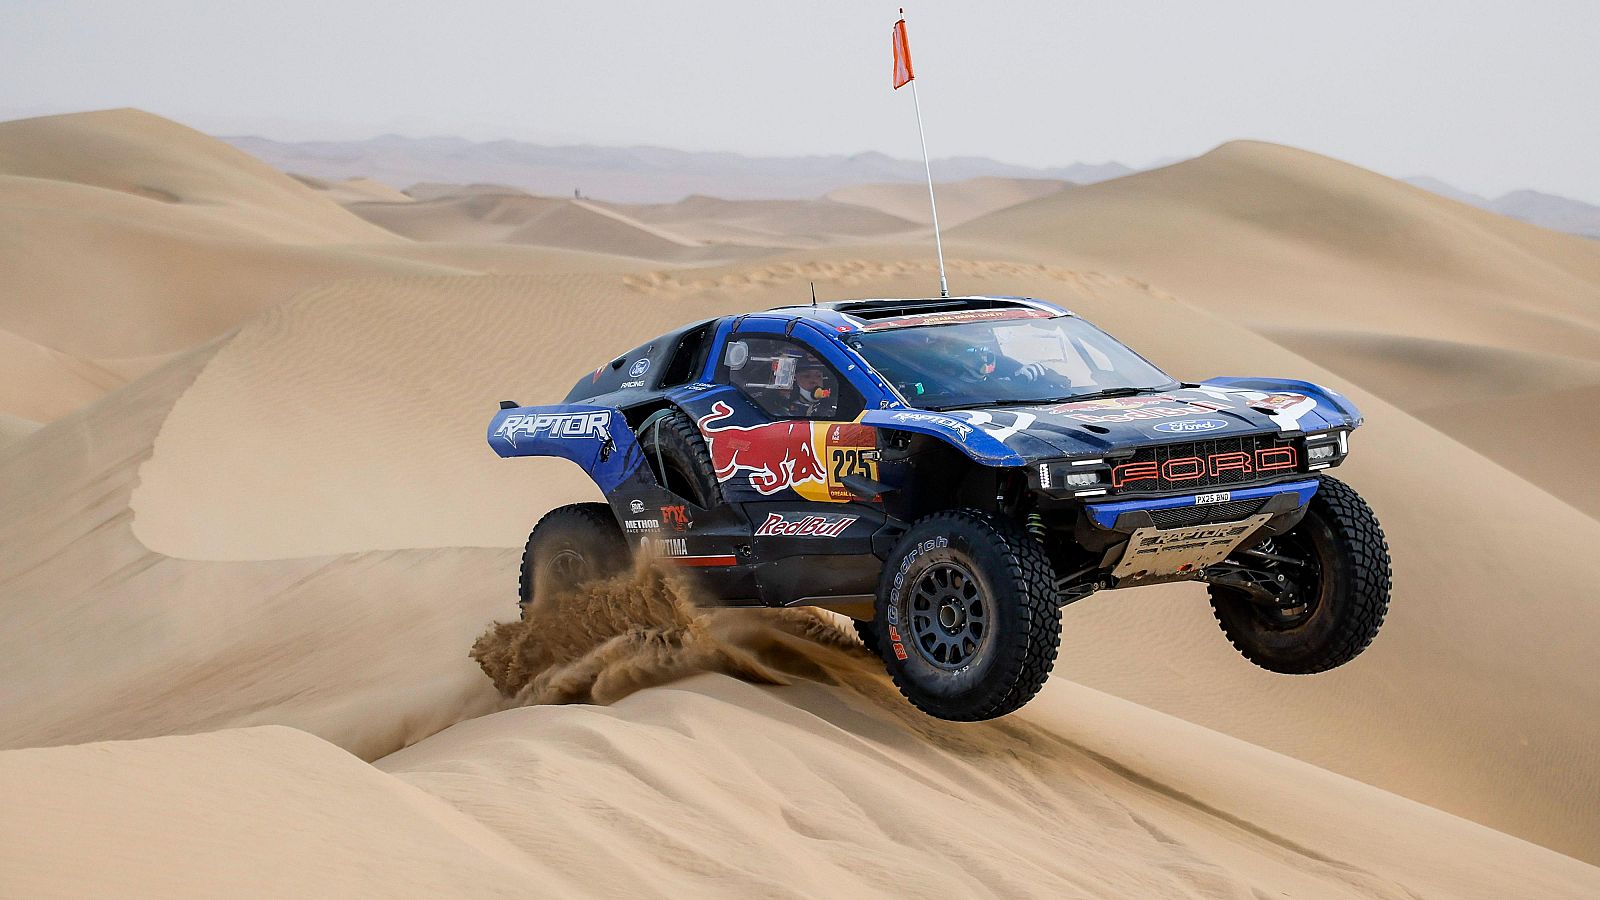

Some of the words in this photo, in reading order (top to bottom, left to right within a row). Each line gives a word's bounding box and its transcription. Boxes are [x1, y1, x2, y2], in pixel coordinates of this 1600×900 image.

[631, 361, 647, 375] Ford
[620, 381, 645, 389] RACING
[494, 410, 617, 452] RAPTOR
[890, 412, 974, 442] RAPTOR
[1169, 421, 1216, 433] Ford
[832, 449, 872, 483] 225
[1112, 446, 1298, 488] FORD
[1197, 494, 1215, 504] PX25
[624, 519, 660, 529] METHOD
[1155, 528, 1229, 544] RAPTOR
[654, 538, 688, 555] OPTIMA
